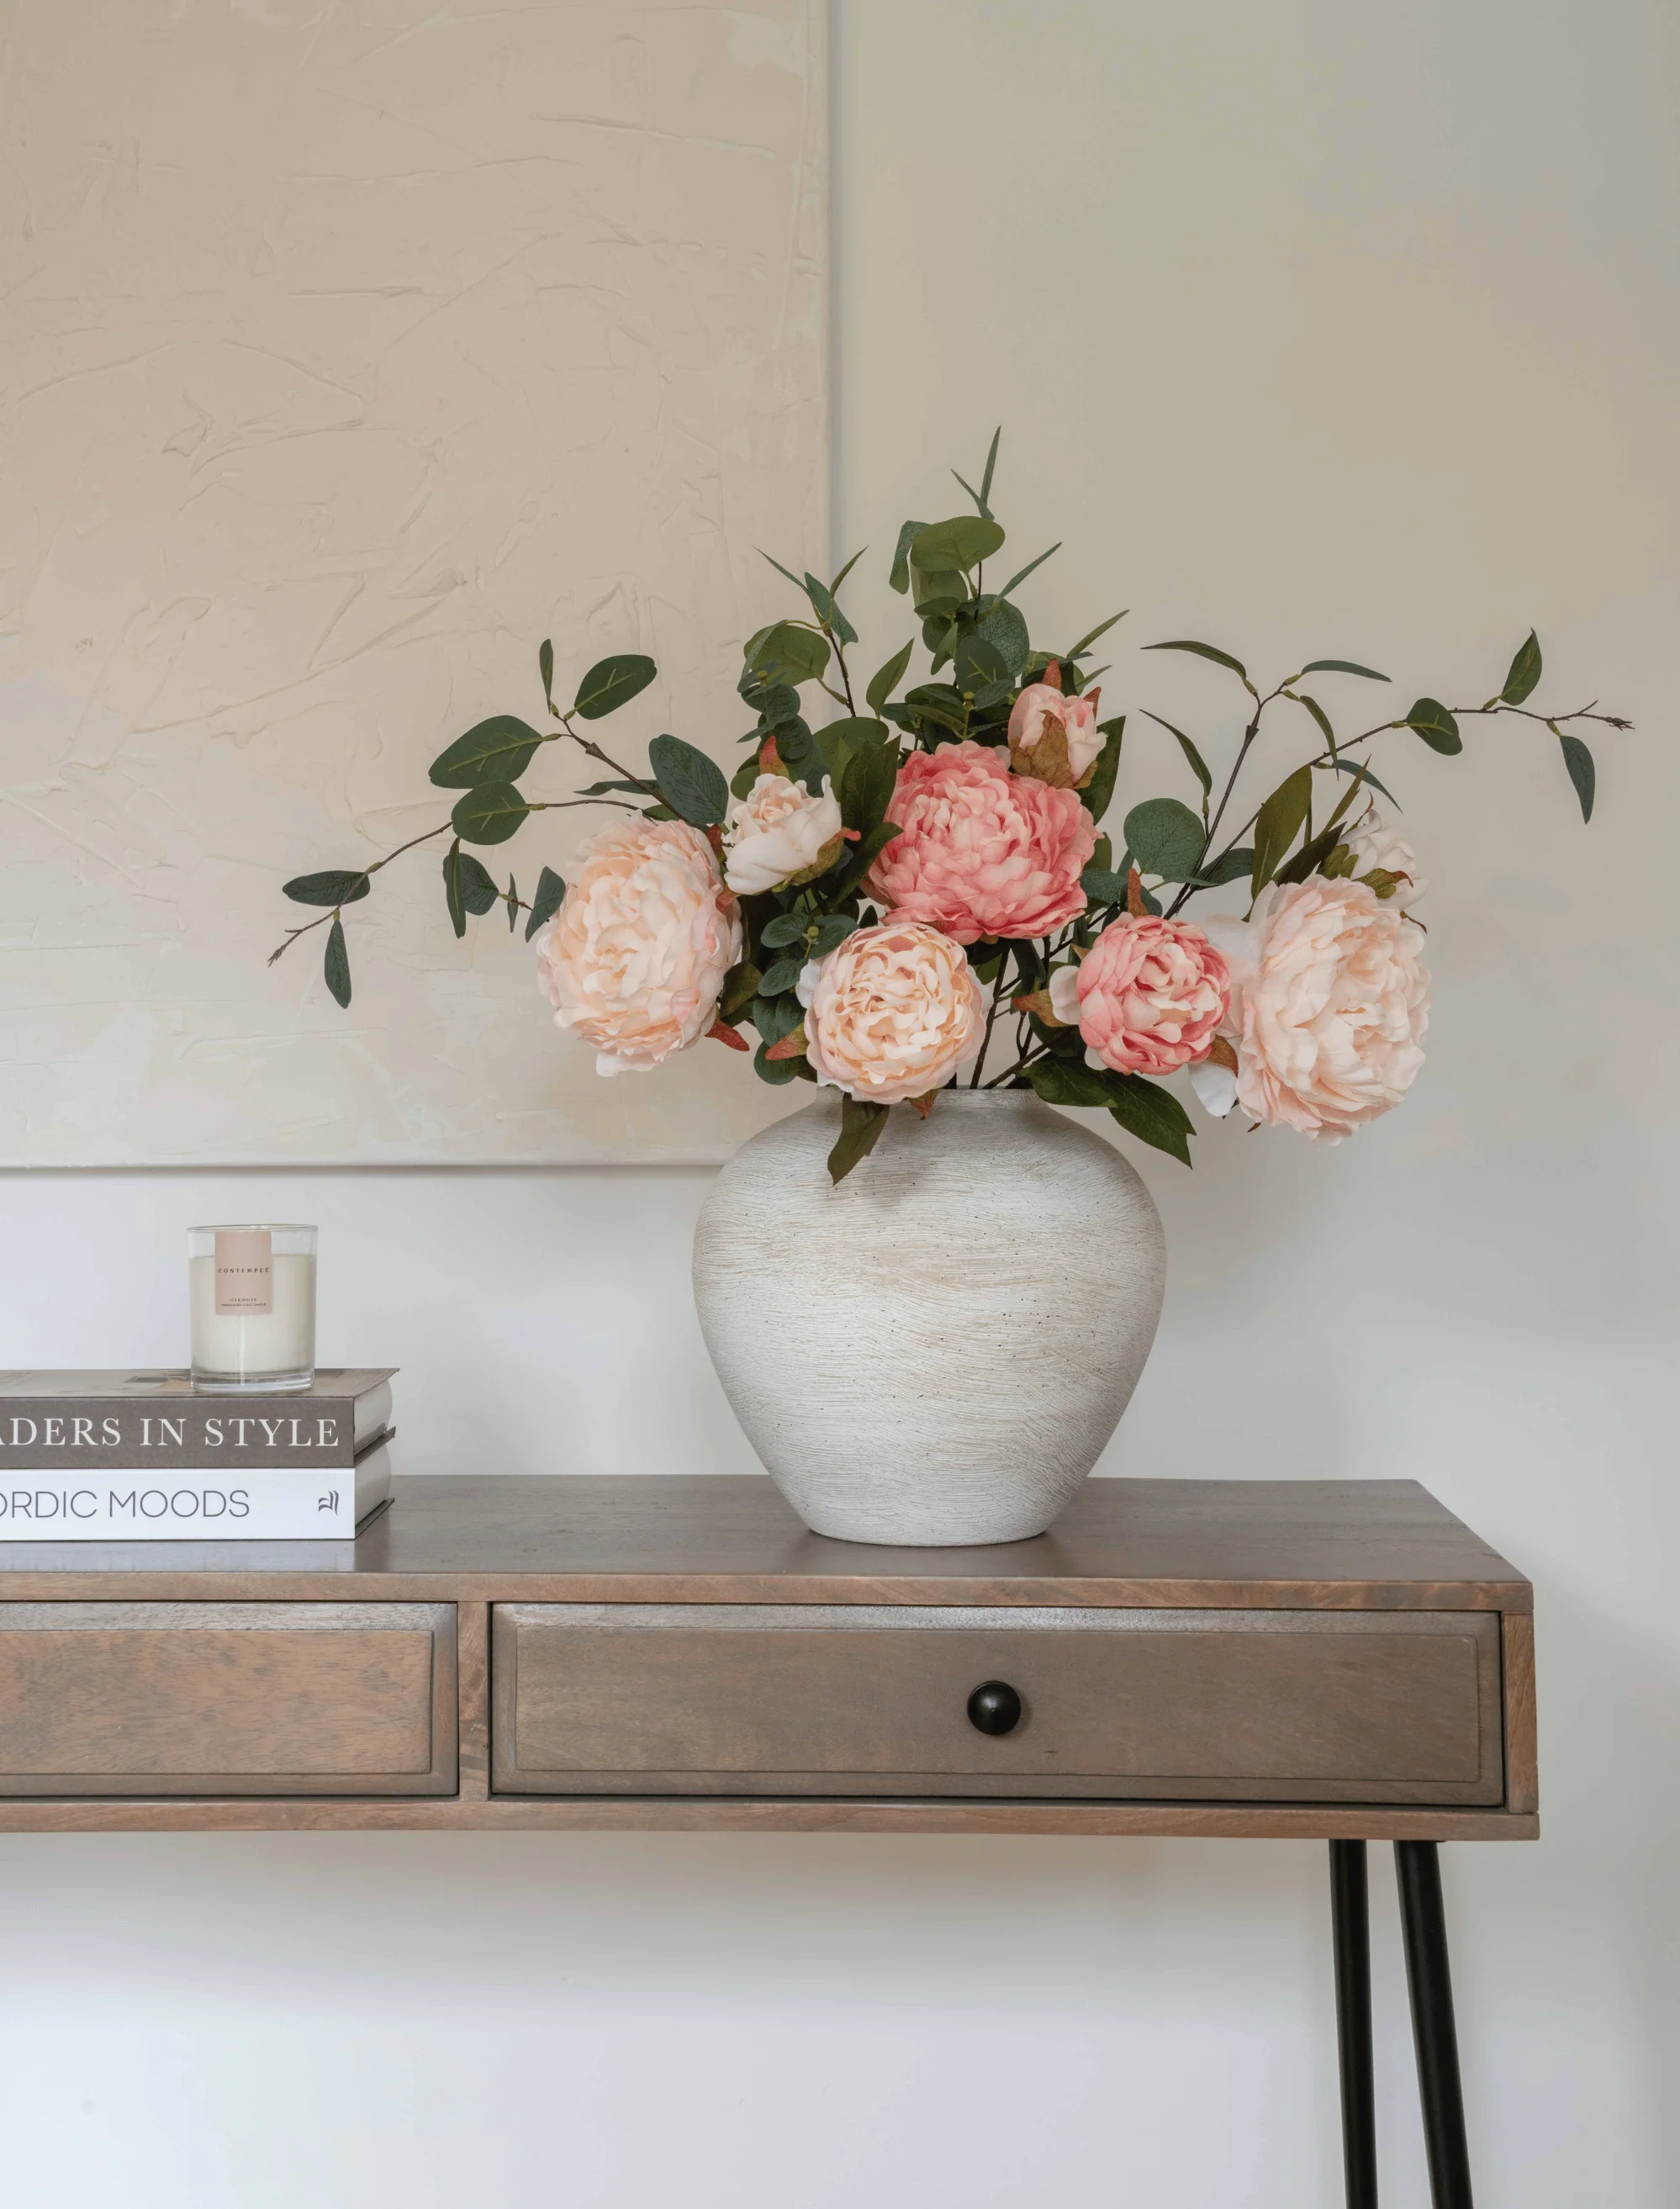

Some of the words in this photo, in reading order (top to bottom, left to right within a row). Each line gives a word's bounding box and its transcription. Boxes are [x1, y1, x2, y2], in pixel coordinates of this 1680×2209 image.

[0, 1418, 121, 1446] DERS
[140, 1419, 186, 1446] IN
[205, 1419, 339, 1446] STYLE
[0, 1491, 98, 1518] RDIC
[109, 1490, 250, 1518] MOODS
